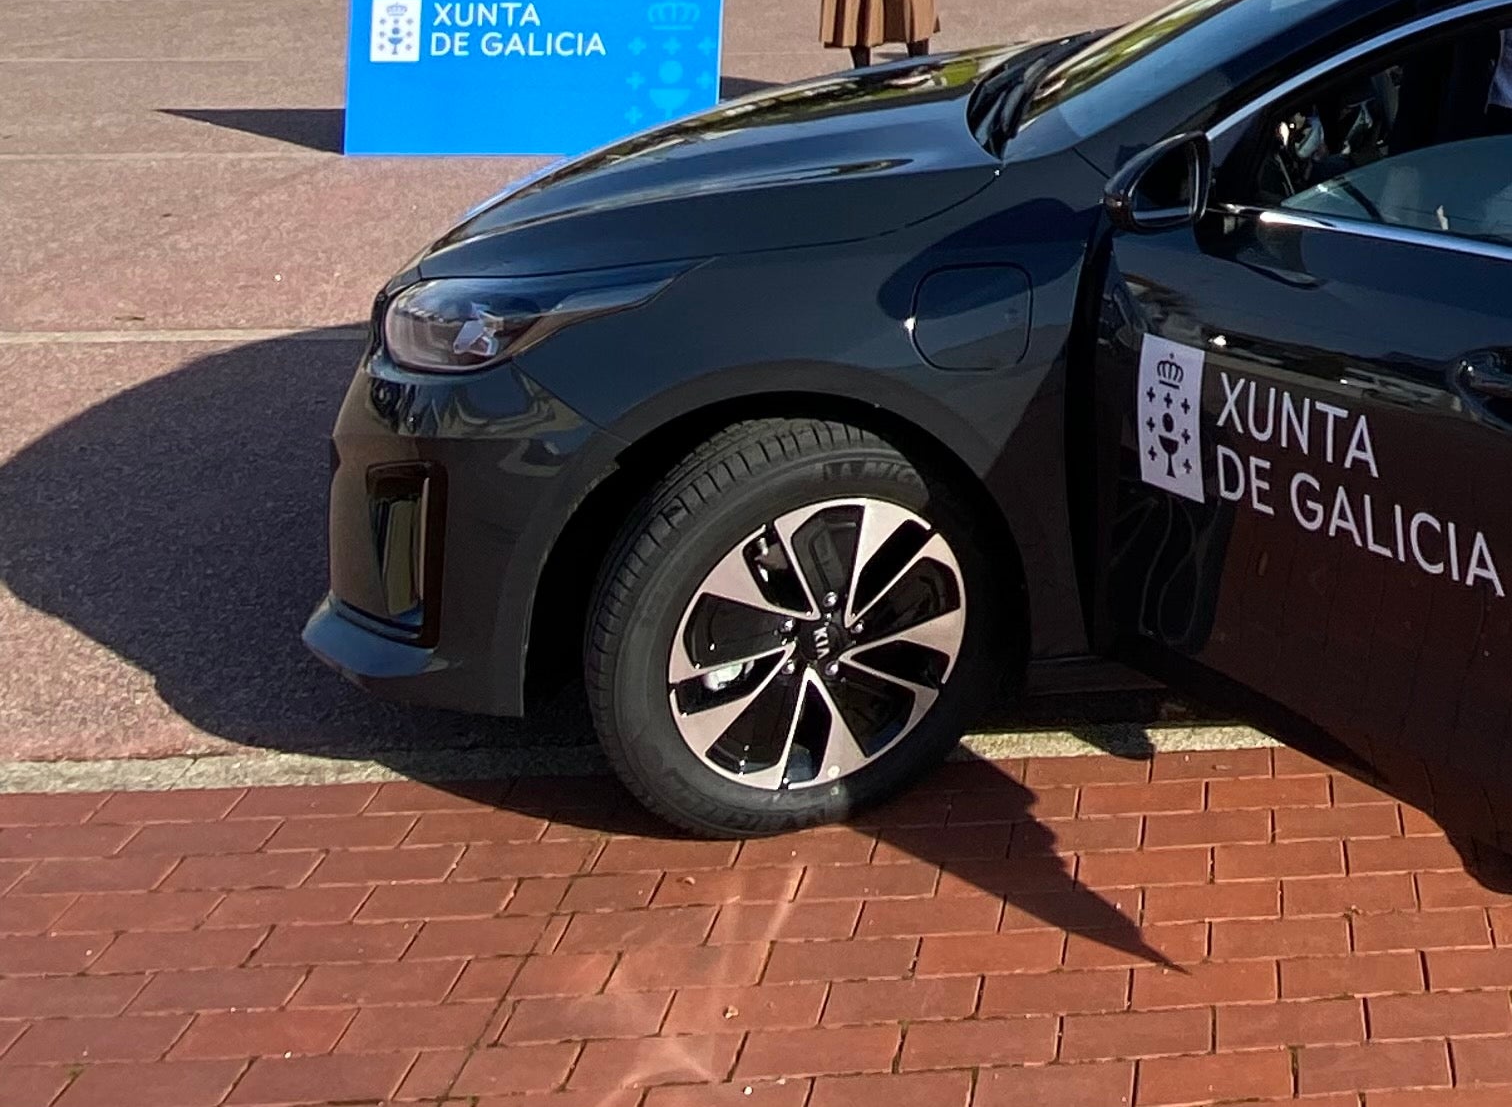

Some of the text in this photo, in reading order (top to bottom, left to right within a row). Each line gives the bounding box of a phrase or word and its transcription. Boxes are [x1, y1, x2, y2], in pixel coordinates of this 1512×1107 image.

[432, 2, 542, 28] XUNTA
[430, 31, 607, 58] DE GALICIA
[1216, 371, 1379, 479] XUNTA
[1216, 444, 1506, 597] DE GALICIA
[813, 626, 830, 660] KIA
